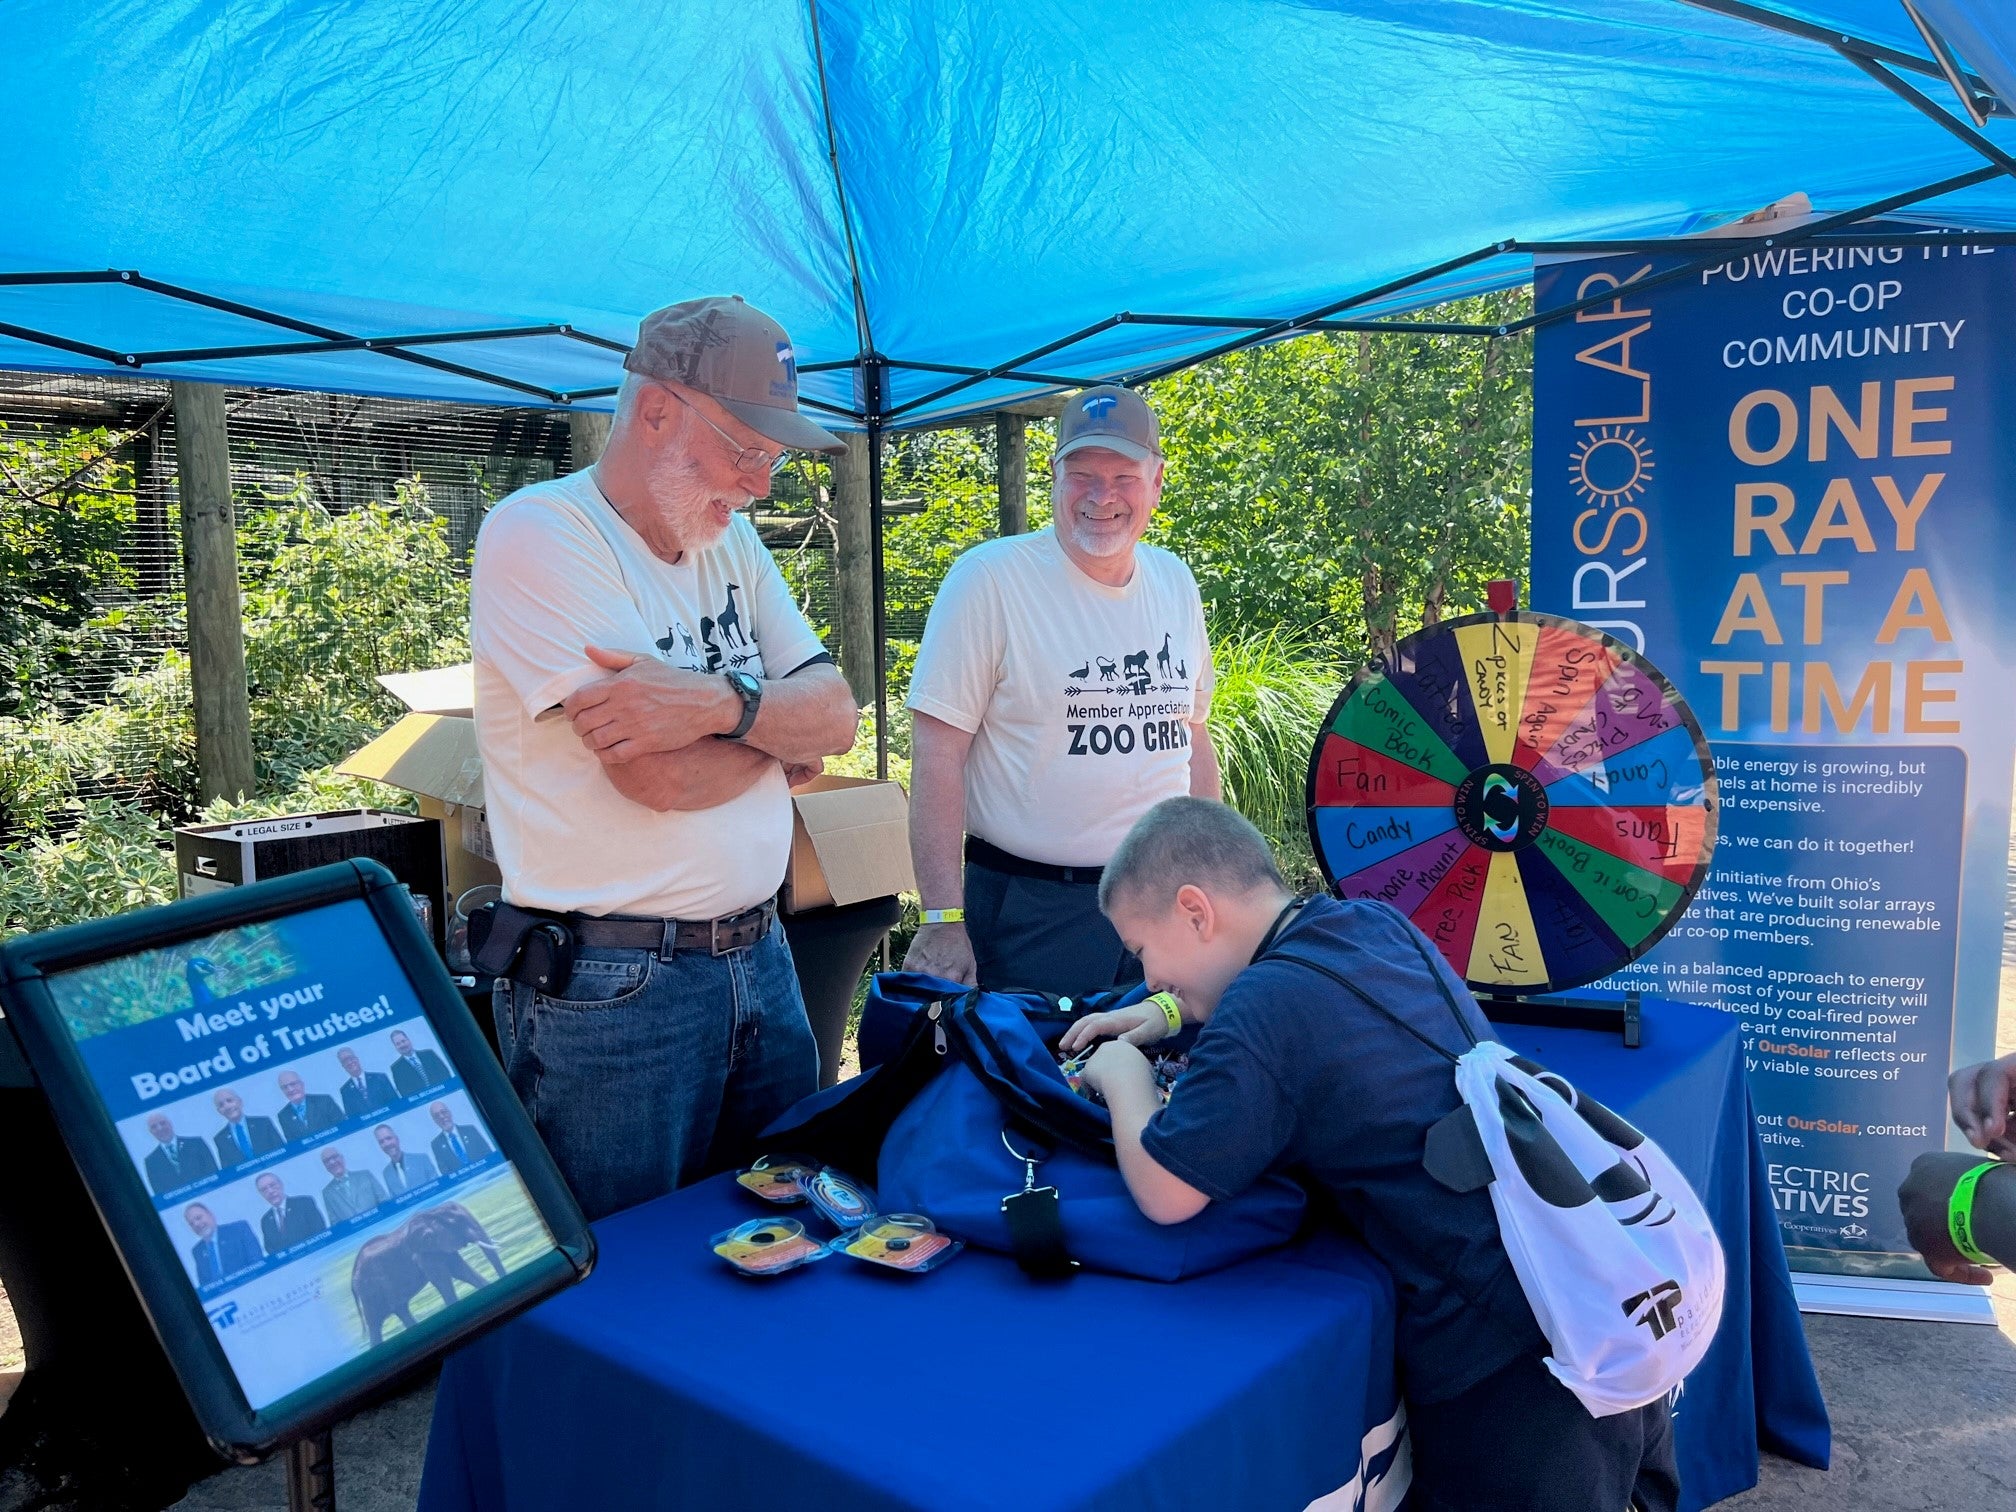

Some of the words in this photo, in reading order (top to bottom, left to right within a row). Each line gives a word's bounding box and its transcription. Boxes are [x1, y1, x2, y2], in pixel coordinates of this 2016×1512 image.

[1782, 280, 1902, 319] CO-OP
[1722, 320, 1965, 368] COMMUNITY
[1728, 375, 1955, 466] ONE
[1733, 473, 1946, 557] RAY
[1711, 570, 1850, 645] AT
[1874, 568, 1953, 644] A
[1552, 648, 1596, 696] Spin
[1066, 704, 1124, 718] Member
[1128, 700, 1191, 720] Appreciation
[1701, 660, 1964, 735] TIME
[1364, 687, 1416, 738] Comic
[1523, 701, 1558, 751] Again
[1067, 724, 1135, 755] ZOO
[1337, 757, 1387, 793] Fan
[1591, 759, 1668, 789] Candy
[1744, 759, 1798, 776] energy
[1803, 760, 1817, 773] is
[1822, 761, 1893, 777] growing,
[1899, 761, 1926, 774] but
[1457, 779, 1474, 803] WIN
[1513, 770, 1540, 793] SPIN
[1751, 778, 1766, 791] at
[1771, 778, 1817, 793] home
[1822, 779, 1836, 794] is
[1841, 780, 1923, 797] incredibly
[1536, 794, 1546, 809] TO
[1740, 798, 1825, 813] expensive.
[1457, 807, 1467, 822] TO
[1527, 812, 1547, 837] WIN
[247, 824, 278, 836] LEGAL
[280, 822, 301, 832] SIZE
[1346, 817, 1413, 849] Candy
[1463, 823, 1488, 845] SPIN
[1615, 820, 1679, 860] Fans
[1736, 837, 1759, 848] we
[1763, 837, 1793, 850] can
[1797, 838, 1819, 851] do
[1824, 838, 1834, 852] it
[1839, 840, 1914, 855] together!
[1415, 841, 1462, 892] Mount
[1445, 863, 1482, 901] Pick
[1716, 870, 1782, 887] initiative
[1787, 874, 1825, 890] from
[1831, 876, 1881, 892] Ohio’s
[1747, 890, 1793, 907] We’ve
[1798, 894, 1834, 910] built
[1839, 896, 1879, 911] solar
[1884, 898, 1936, 913] arrays
[1704, 908, 1735, 921] that
[1739, 911, 1765, 924] are
[1768, 912, 1850, 931] producing
[1855, 916, 1941, 931] renewable
[1686, 926, 1729, 941] co-op
[1734, 928, 1814, 947] members.
[1617, 962, 1659, 975] lieve
[1663, 962, 1676, 975] in
[1680, 964, 1689, 975] a
[1693, 962, 1763, 978] balanced
[1768, 969, 1844, 985] approach
[1849, 974, 1865, 986] to
[1870, 976, 1925, 991] energy
[1579, 977, 1662, 993] roduction.
[1667, 980, 1708, 993] While
[1712, 982, 1752, 996] most
[1756, 985, 1774, 998] of
[1777, 990, 1812, 1002] your
[1817, 991, 1896, 1009] electricity
[1900, 993, 1927, 1007] will
[175, 1001, 258, 1043] Meet
[259, 982, 325, 1021] your
[1764, 1004, 1783, 1020] by
[1787, 1008, 1862, 1023] coal-fired
[1867, 1014, 1918, 1027] power
[1781, 1026, 1897, 1043] environmental
[130, 1045, 237, 1101] Board
[239, 1033, 272, 1064] of
[271, 994, 394, 1052] Trustees!
[1759, 1040, 1830, 1059] OurSolar
[1835, 1048, 1895, 1062] reflects
[1900, 1051, 1927, 1062] our
[1762, 1059, 1809, 1075] viable
[1814, 1066, 1878, 1080] sources
[1882, 1068, 1900, 1080] of
[1787, 1116, 1863, 1136] OurSolar,
[1866, 1124, 1927, 1137] contact
[1768, 1164, 1870, 1193] ECTRIC
[1783, 1221, 1838, 1235] Cooperatives
